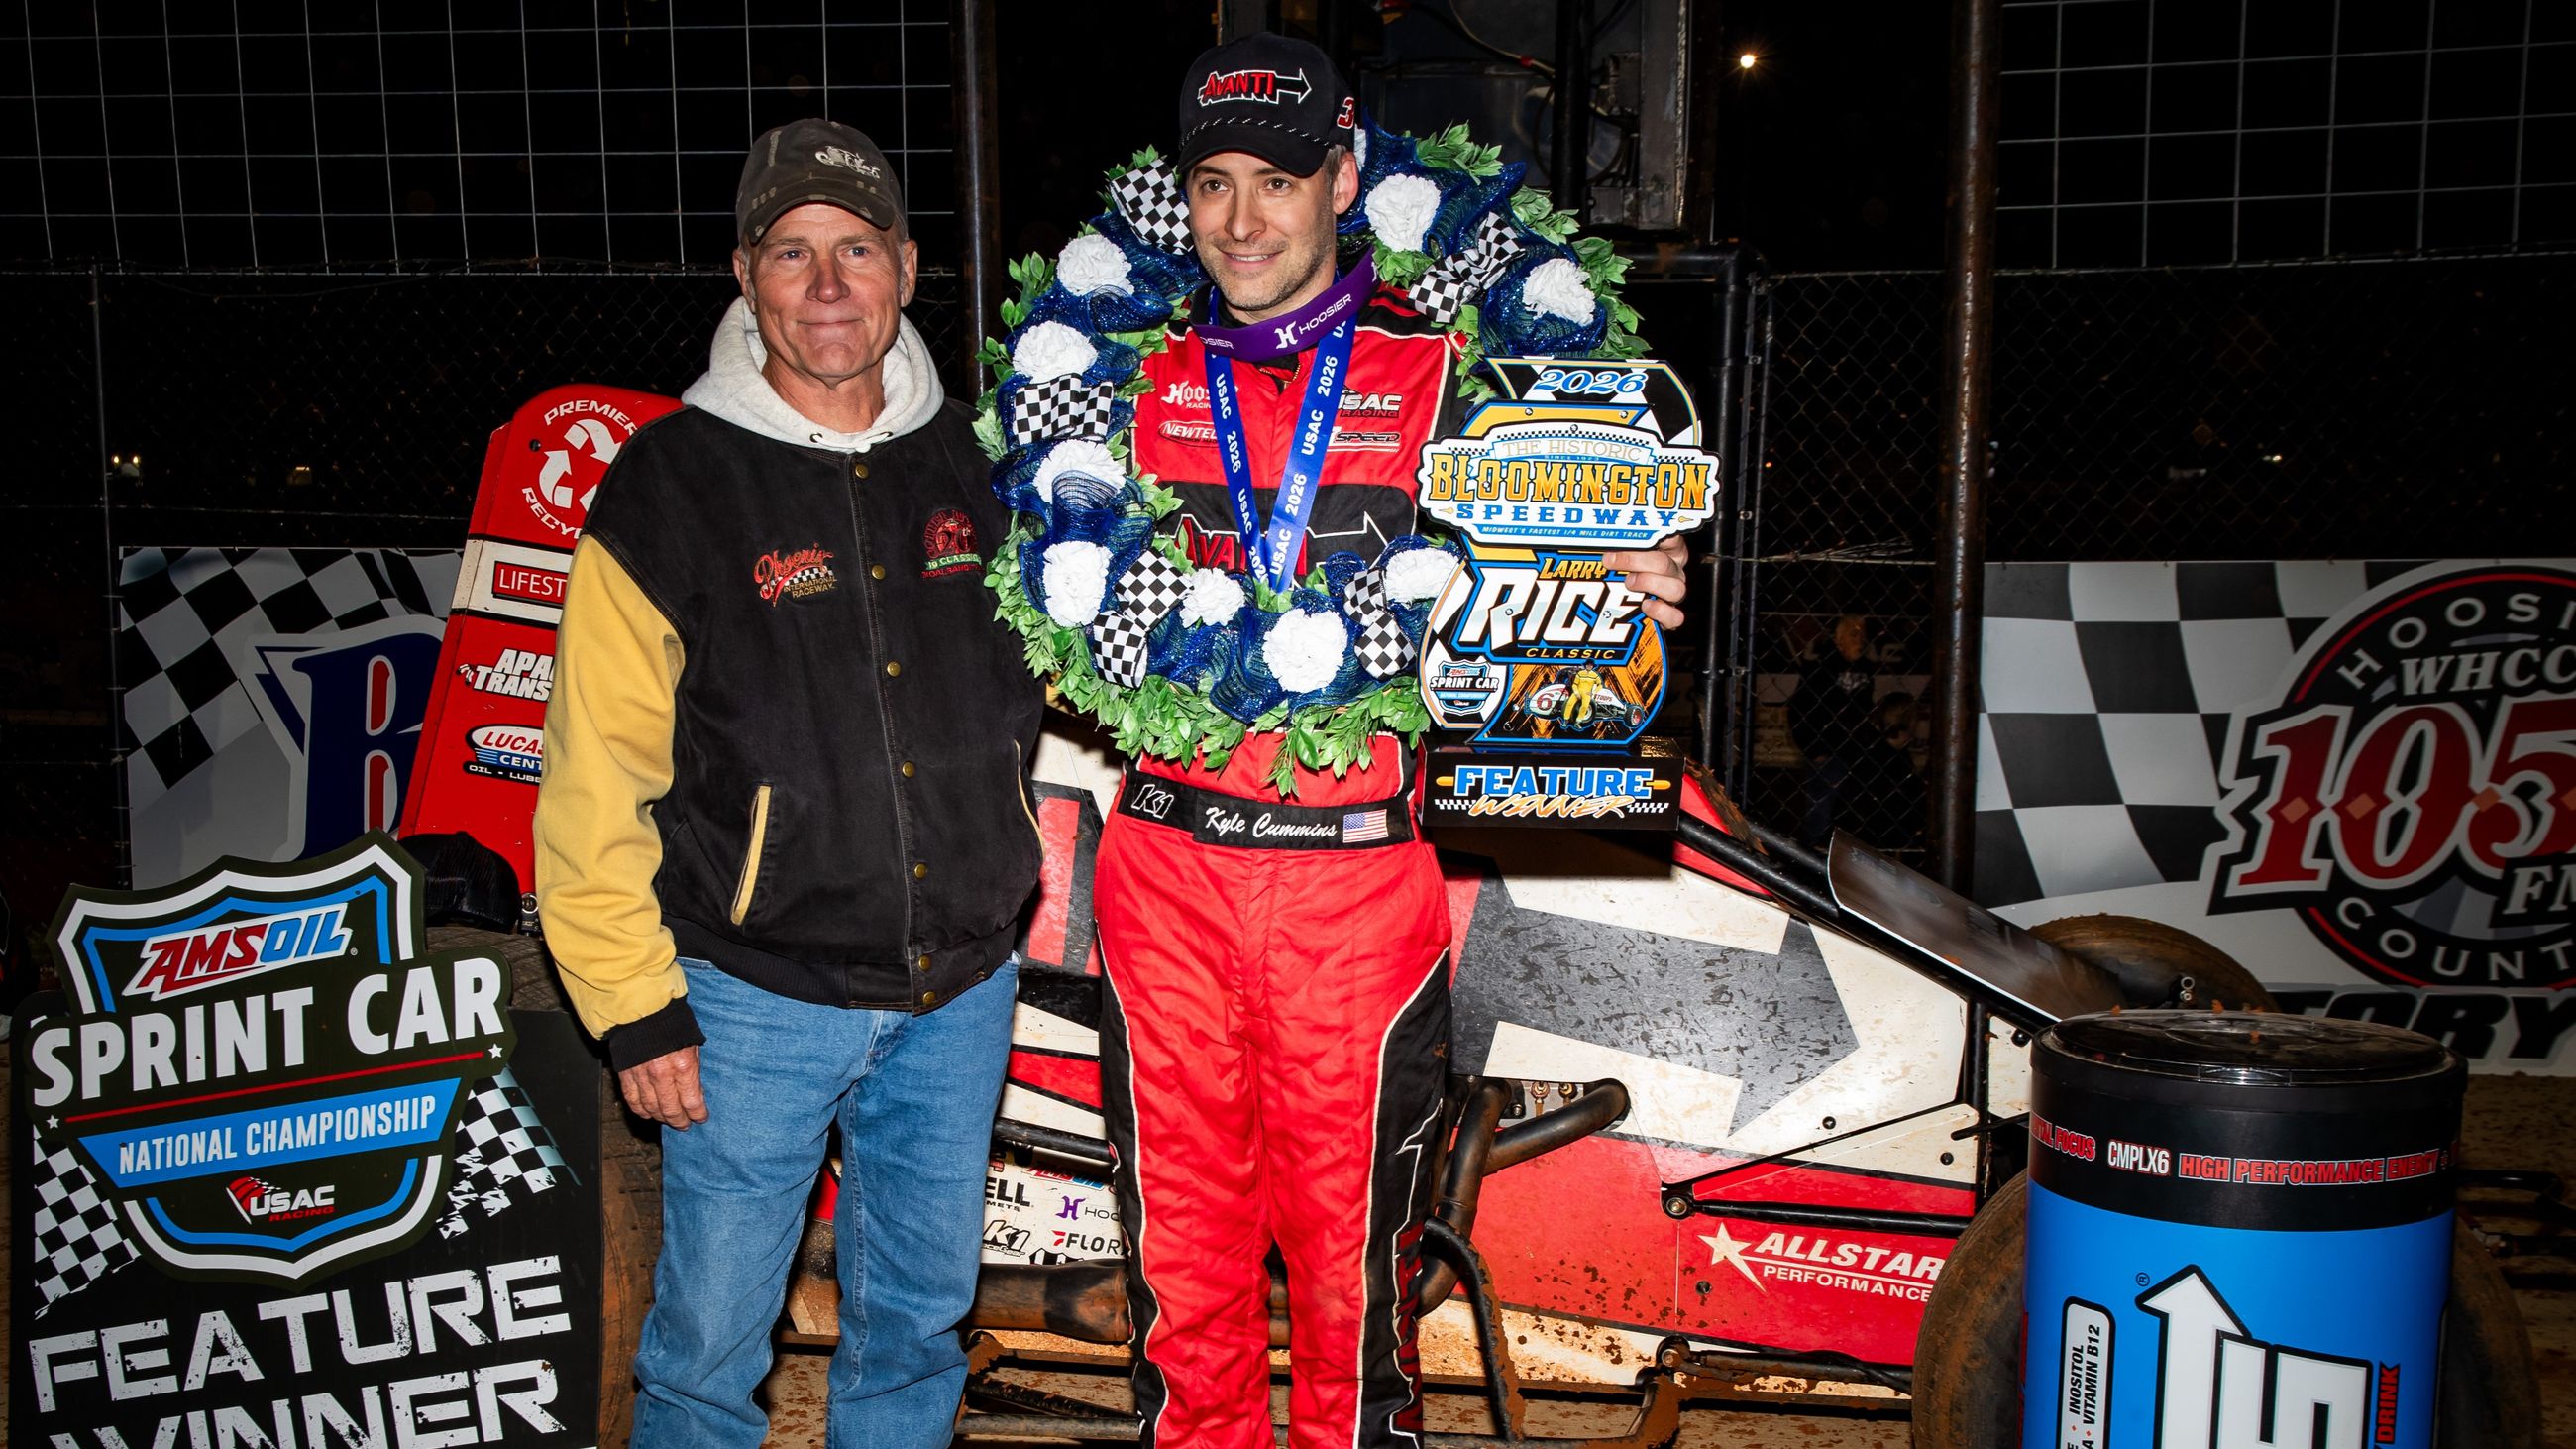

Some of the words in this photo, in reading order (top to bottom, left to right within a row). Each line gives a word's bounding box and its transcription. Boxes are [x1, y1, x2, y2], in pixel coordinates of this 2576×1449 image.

[1201, 71, 1275, 103] AVANTI
[1337, 97, 1355, 129] 3
[1298, 293, 1352, 335] HOOSIER
[1533, 369, 1649, 395] 2026
[544, 400, 638, 436] PREMIER
[1216, 373, 1232, 419] USAC
[1227, 430, 1241, 473] 2026
[1237, 488, 1252, 534] USAC
[1269, 528, 1292, 575] USAC
[1285, 474, 1307, 516] 2026
[1301, 409, 1324, 456] USAC
[1317, 355, 1338, 397] 2026
[1503, 439, 1541, 456] THE
[1548, 439, 1643, 462] HISTORIC
[1429, 452, 1711, 510] BLOOMINGTON
[1456, 503, 1678, 527] SPEEDWAY
[499, 569, 568, 597] LIFEST
[783, 576, 837, 592] INTERNATIONAL
[1540, 558, 1606, 580] LARRY
[1459, 566, 1646, 651] RICE
[493, 649, 555, 681] APA
[1526, 648, 1616, 659] CLASSIC
[1431, 677, 1473, 688] SPRINT
[1475, 678, 1498, 689] CAR
[1537, 693, 1554, 711] 6
[469, 765, 492, 774] OIL
[1454, 765, 1655, 799] FEATURE
[1131, 784, 1174, 819] K1
[1468, 794, 1636, 819] WINNER
[1205, 807, 1245, 838] Kyle
[1252, 813, 1338, 838] Cummins
[135, 903, 354, 993] AMSOIL
[32, 986, 313, 1107] SPRINT
[347, 957, 504, 1055] CAR
[118, 1124, 238, 1175] NATIONAL
[245, 1095, 437, 1156] CHAMPIONSHIP
[2055, 1126, 2096, 1162] FOCUS
[2107, 1140, 2171, 1175] CMPLX6
[2180, 1153, 2231, 1182] HIGH
[2233, 1157, 2385, 1185] PERFORMANCE
[248, 1185, 335, 1217] USAC
[268, 1205, 335, 1222] RACING
[982, 1219, 1031, 1252] K1
[1755, 1233, 1946, 1281] ALLSTAR
[1763, 1265, 1932, 1303] PERFORMANCE
[28, 1255, 572, 1414] FEATURE
[2088, 1324, 2100, 1357] B12
[2069, 1345, 2084, 1415] INOSITOL
[2083, 1361, 2098, 1425] VITAMIN
[2376, 1364, 2400, 1444] DRINK
